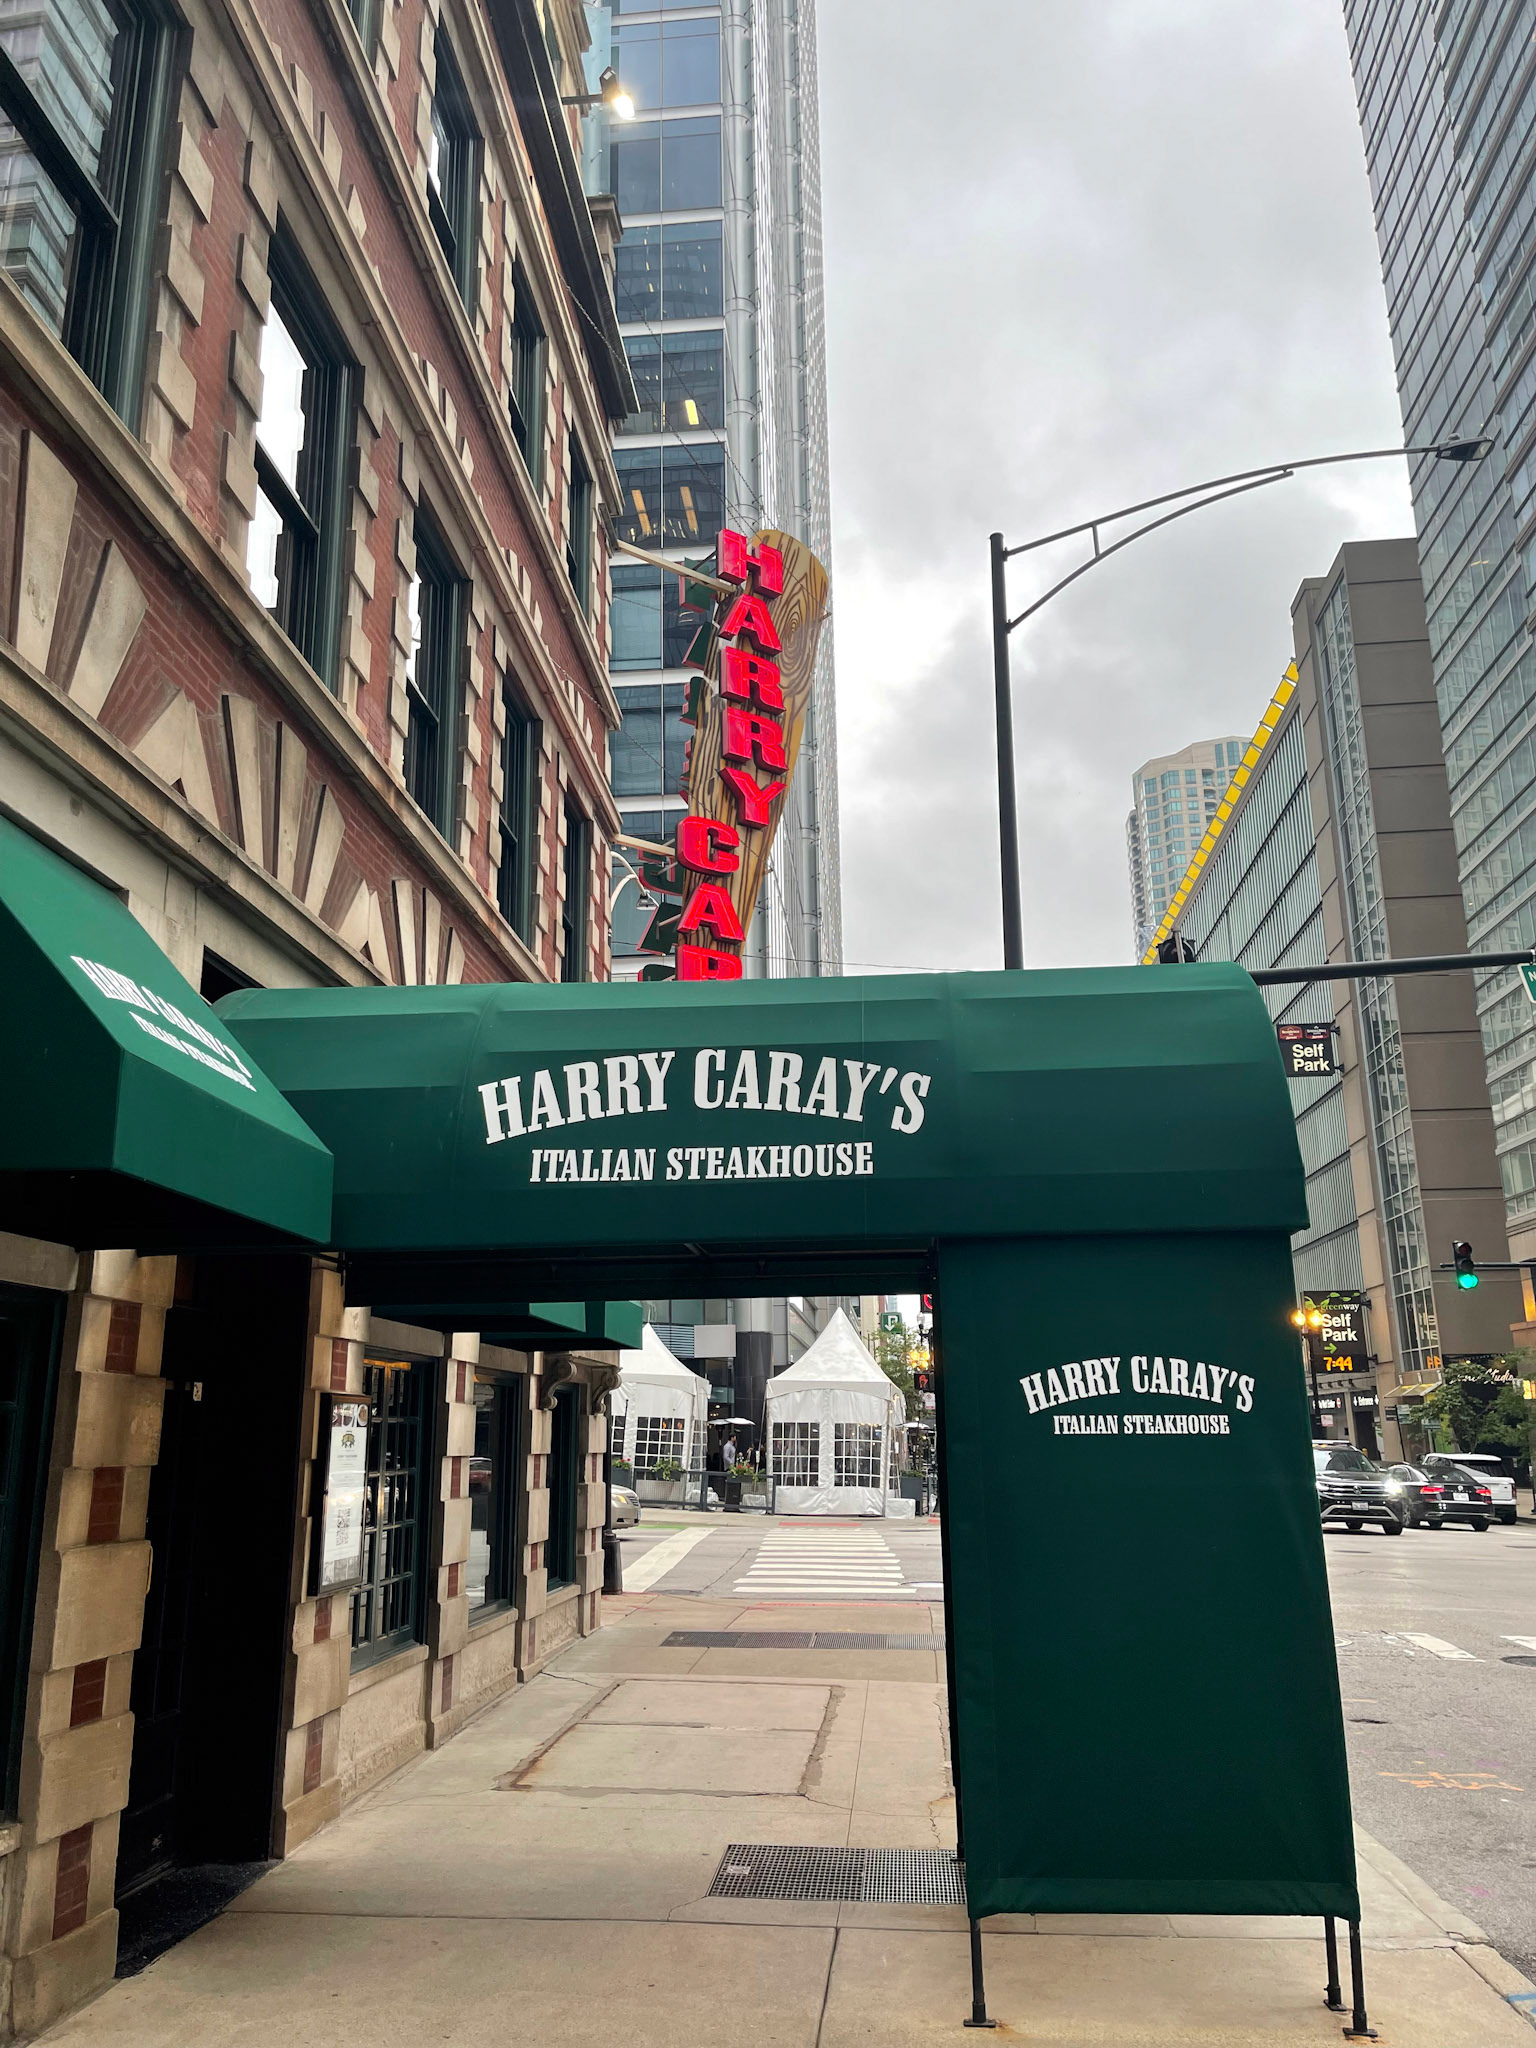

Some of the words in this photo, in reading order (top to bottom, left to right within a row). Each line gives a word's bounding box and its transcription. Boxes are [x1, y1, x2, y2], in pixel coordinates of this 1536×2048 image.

[716, 528, 788, 830] HARRY
[1292, 1043, 1325, 1058] Self
[1293, 1058, 1331, 1072] Park
[477, 1050, 676, 1146] HARRY
[694, 1047, 932, 1135] CARAY'S
[529, 1148, 656, 1184] ITALIAN
[665, 1141, 874, 1182] STEAKHOUSE
[1320, 1303, 1360, 1312] greenway
[1321, 1313, 1352, 1328] Self
[1322, 1328, 1358, 1342] Park
[1323, 1356, 1353, 1371] 7:44
[1019, 1356, 1121, 1415] HARRY
[1130, 1355, 1256, 1413] CARAY'S
[1053, 1414, 1119, 1435] ITALIAN
[1123, 1414, 1231, 1435] STEAKHOUSE
